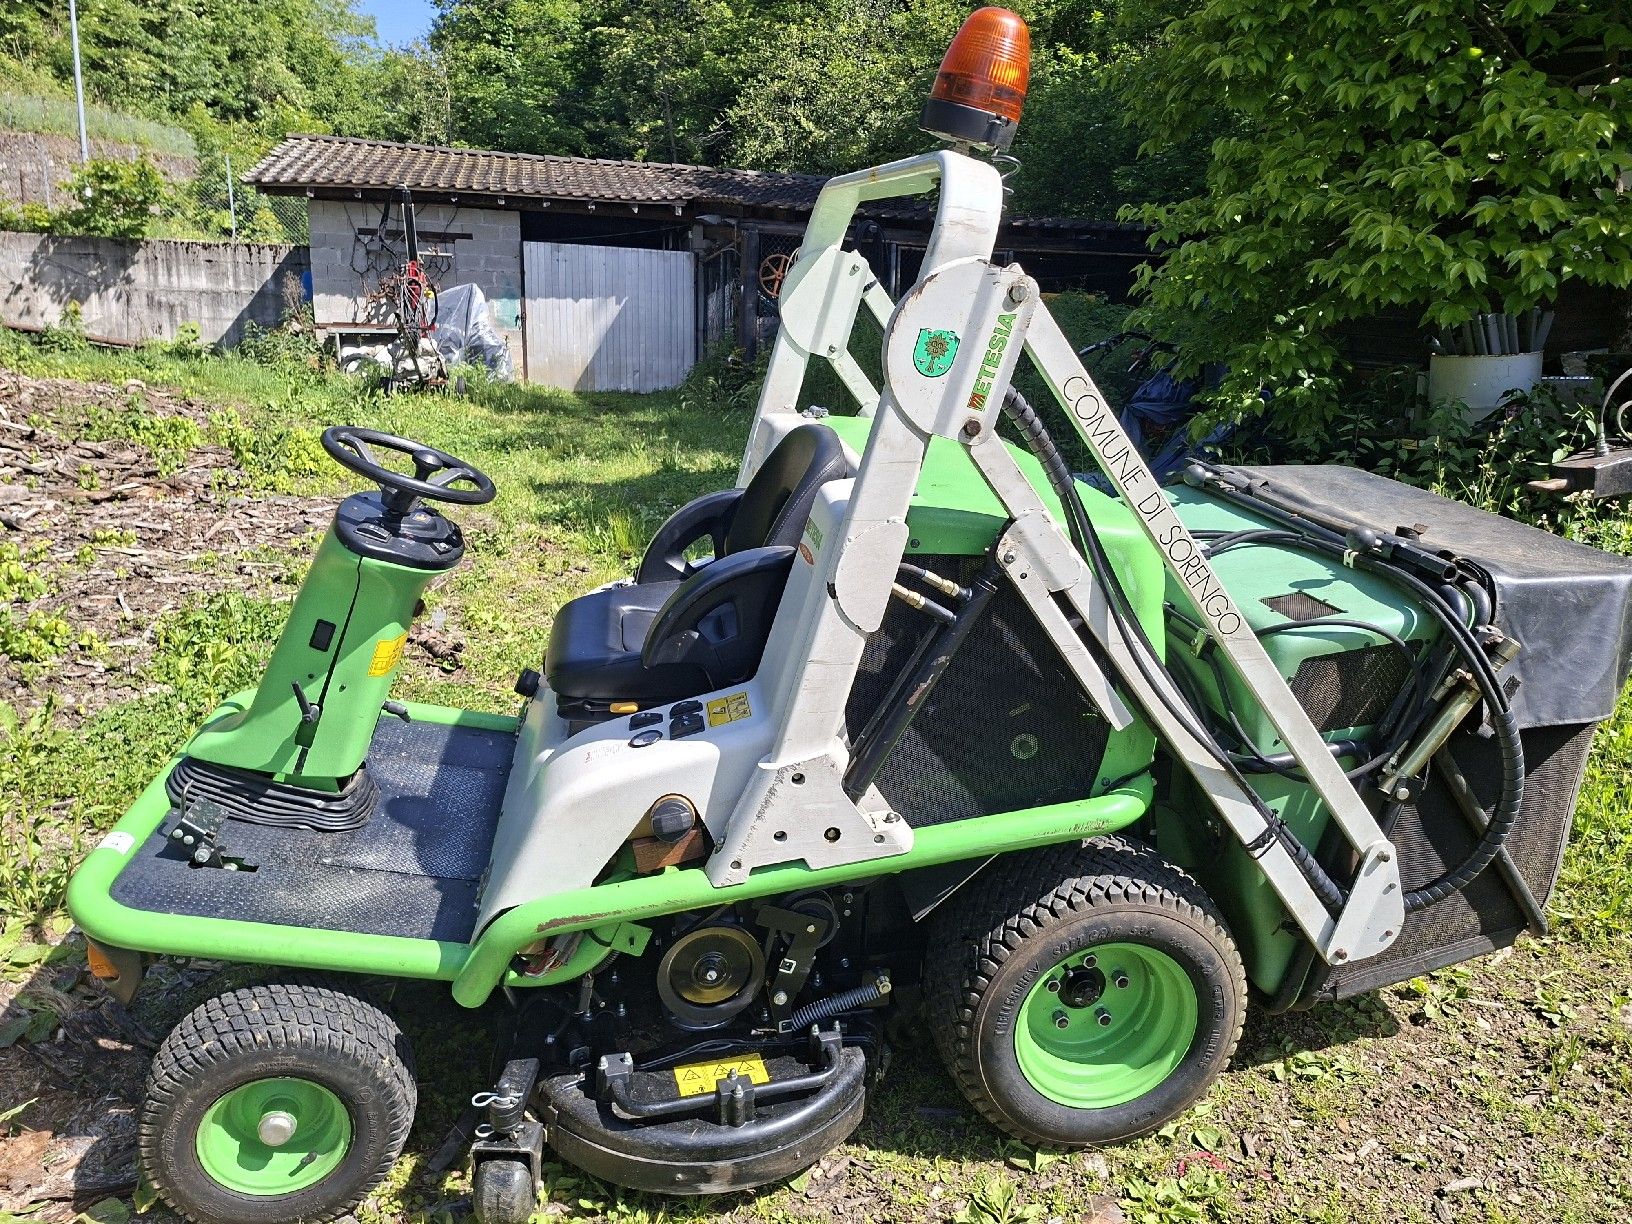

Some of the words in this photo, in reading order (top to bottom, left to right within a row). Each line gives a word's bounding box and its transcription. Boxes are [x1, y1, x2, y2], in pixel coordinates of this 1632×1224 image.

[1063, 376, 1147, 491] COMUNE
[1137, 491, 1167, 522] DI
[1159, 525, 1241, 635] SORENGO
